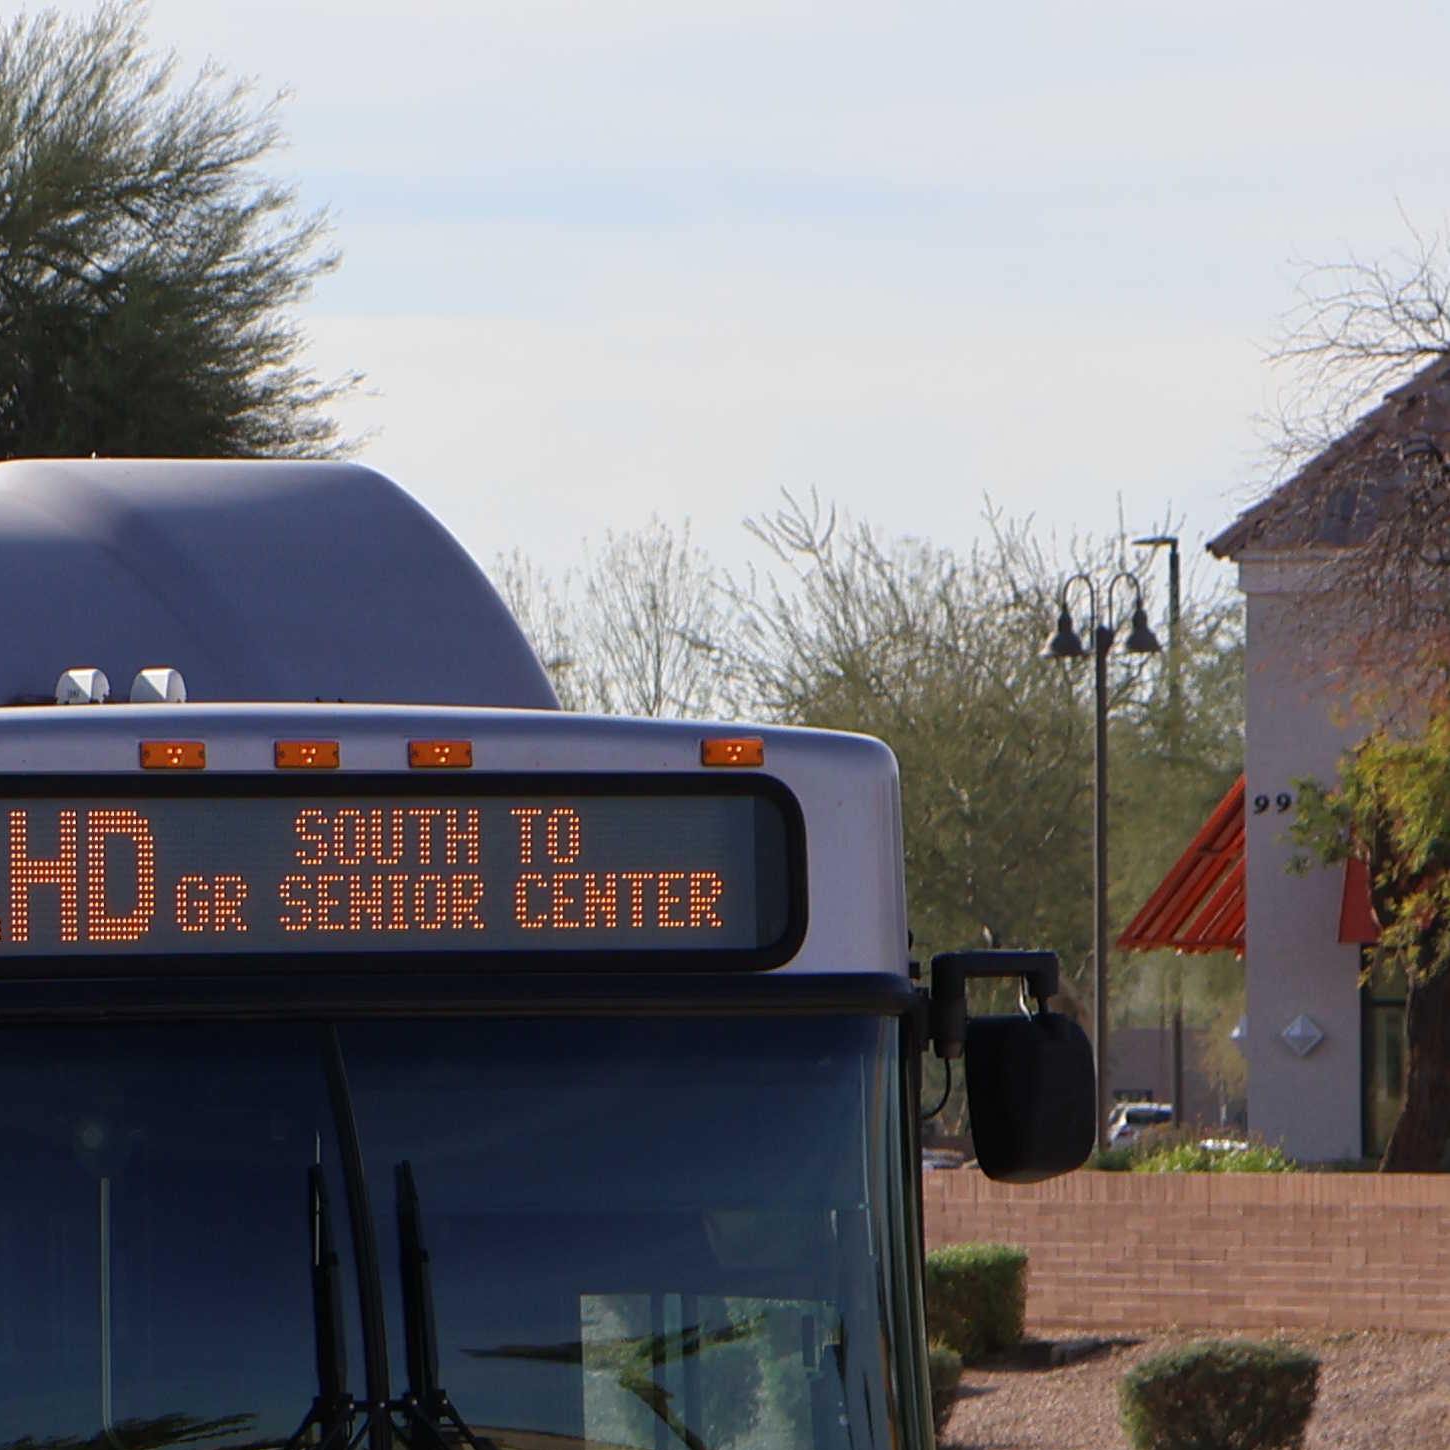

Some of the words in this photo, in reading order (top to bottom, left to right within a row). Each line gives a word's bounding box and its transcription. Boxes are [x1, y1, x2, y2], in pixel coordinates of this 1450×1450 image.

[294, 808, 481, 866] SOUTH
[510, 807, 581, 865] TO
[175, 874, 250, 933] GR
[279, 873, 486, 932] SENIOR
[515, 872, 724, 930] CENTER
